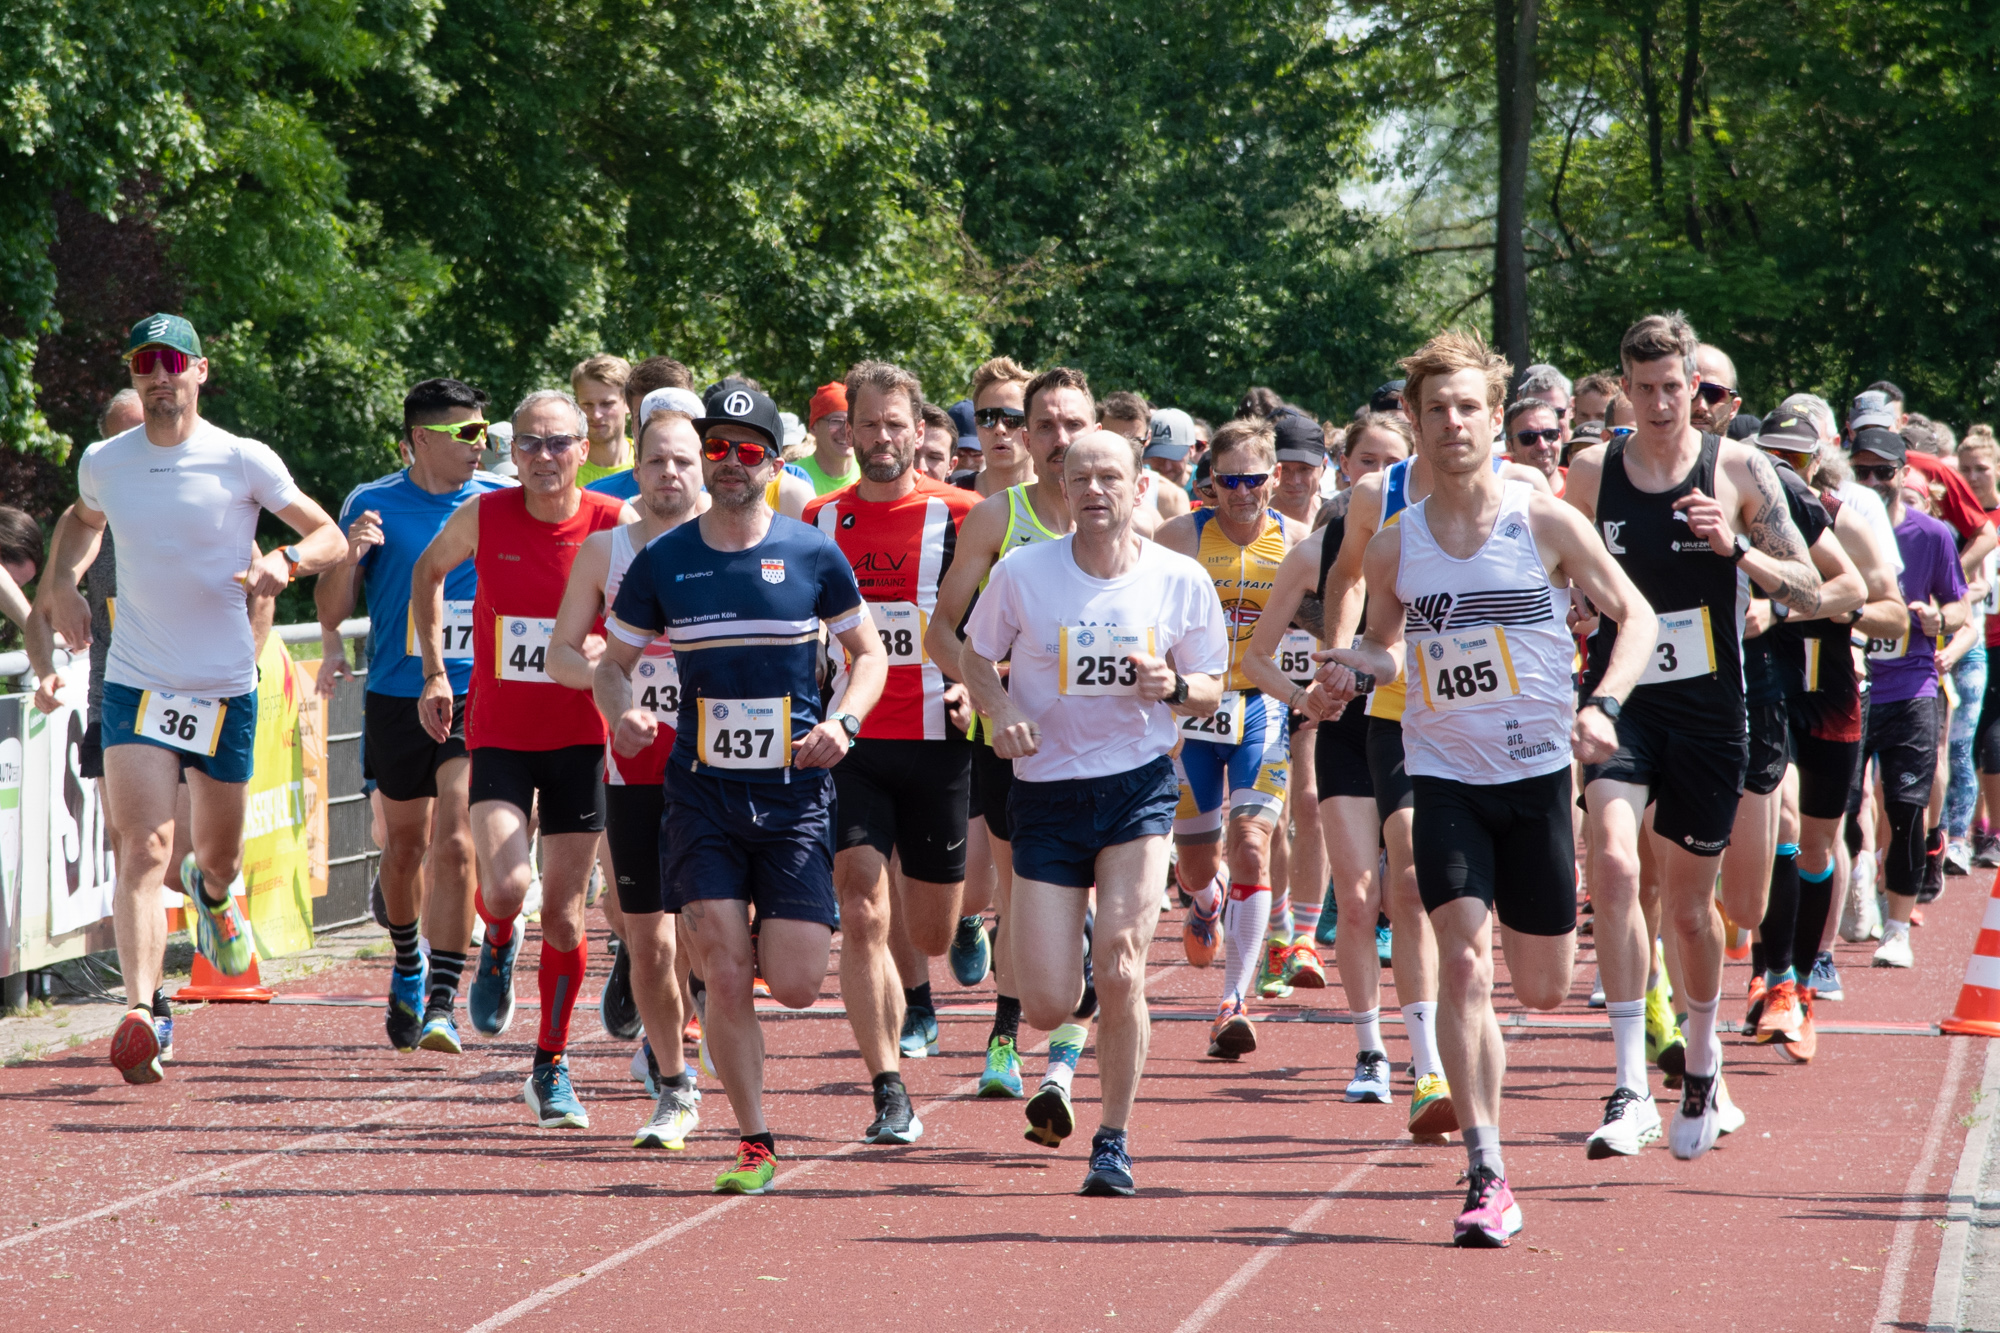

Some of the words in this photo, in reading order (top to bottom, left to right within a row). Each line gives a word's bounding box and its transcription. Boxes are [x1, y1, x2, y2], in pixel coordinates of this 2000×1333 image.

[1153, 424, 1172, 438] LA
[853, 552, 907, 571] ALV
[875, 577, 906, 587] MAINZ
[1212, 579, 1232, 588] EC
[693, 613, 720, 623] Zentrum
[721, 611, 737, 620] Köln
[1667, 618, 1693, 629] DELCREDA
[1460, 638, 1488, 650] DELCREDA
[1281, 650, 1309, 673] 65
[1656, 643, 1678, 672] 3
[1076, 655, 1138, 687] 253
[1436, 659, 1499, 700] 485
[640, 685, 679, 712] 43
[159, 708, 198, 741] 36
[1182, 711, 1231, 736] 228
[1505, 719, 1521, 731] we.
[713, 728, 774, 759] 437
[1507, 733, 1526, 747] are.
[1509, 740, 1560, 761] endurance.
